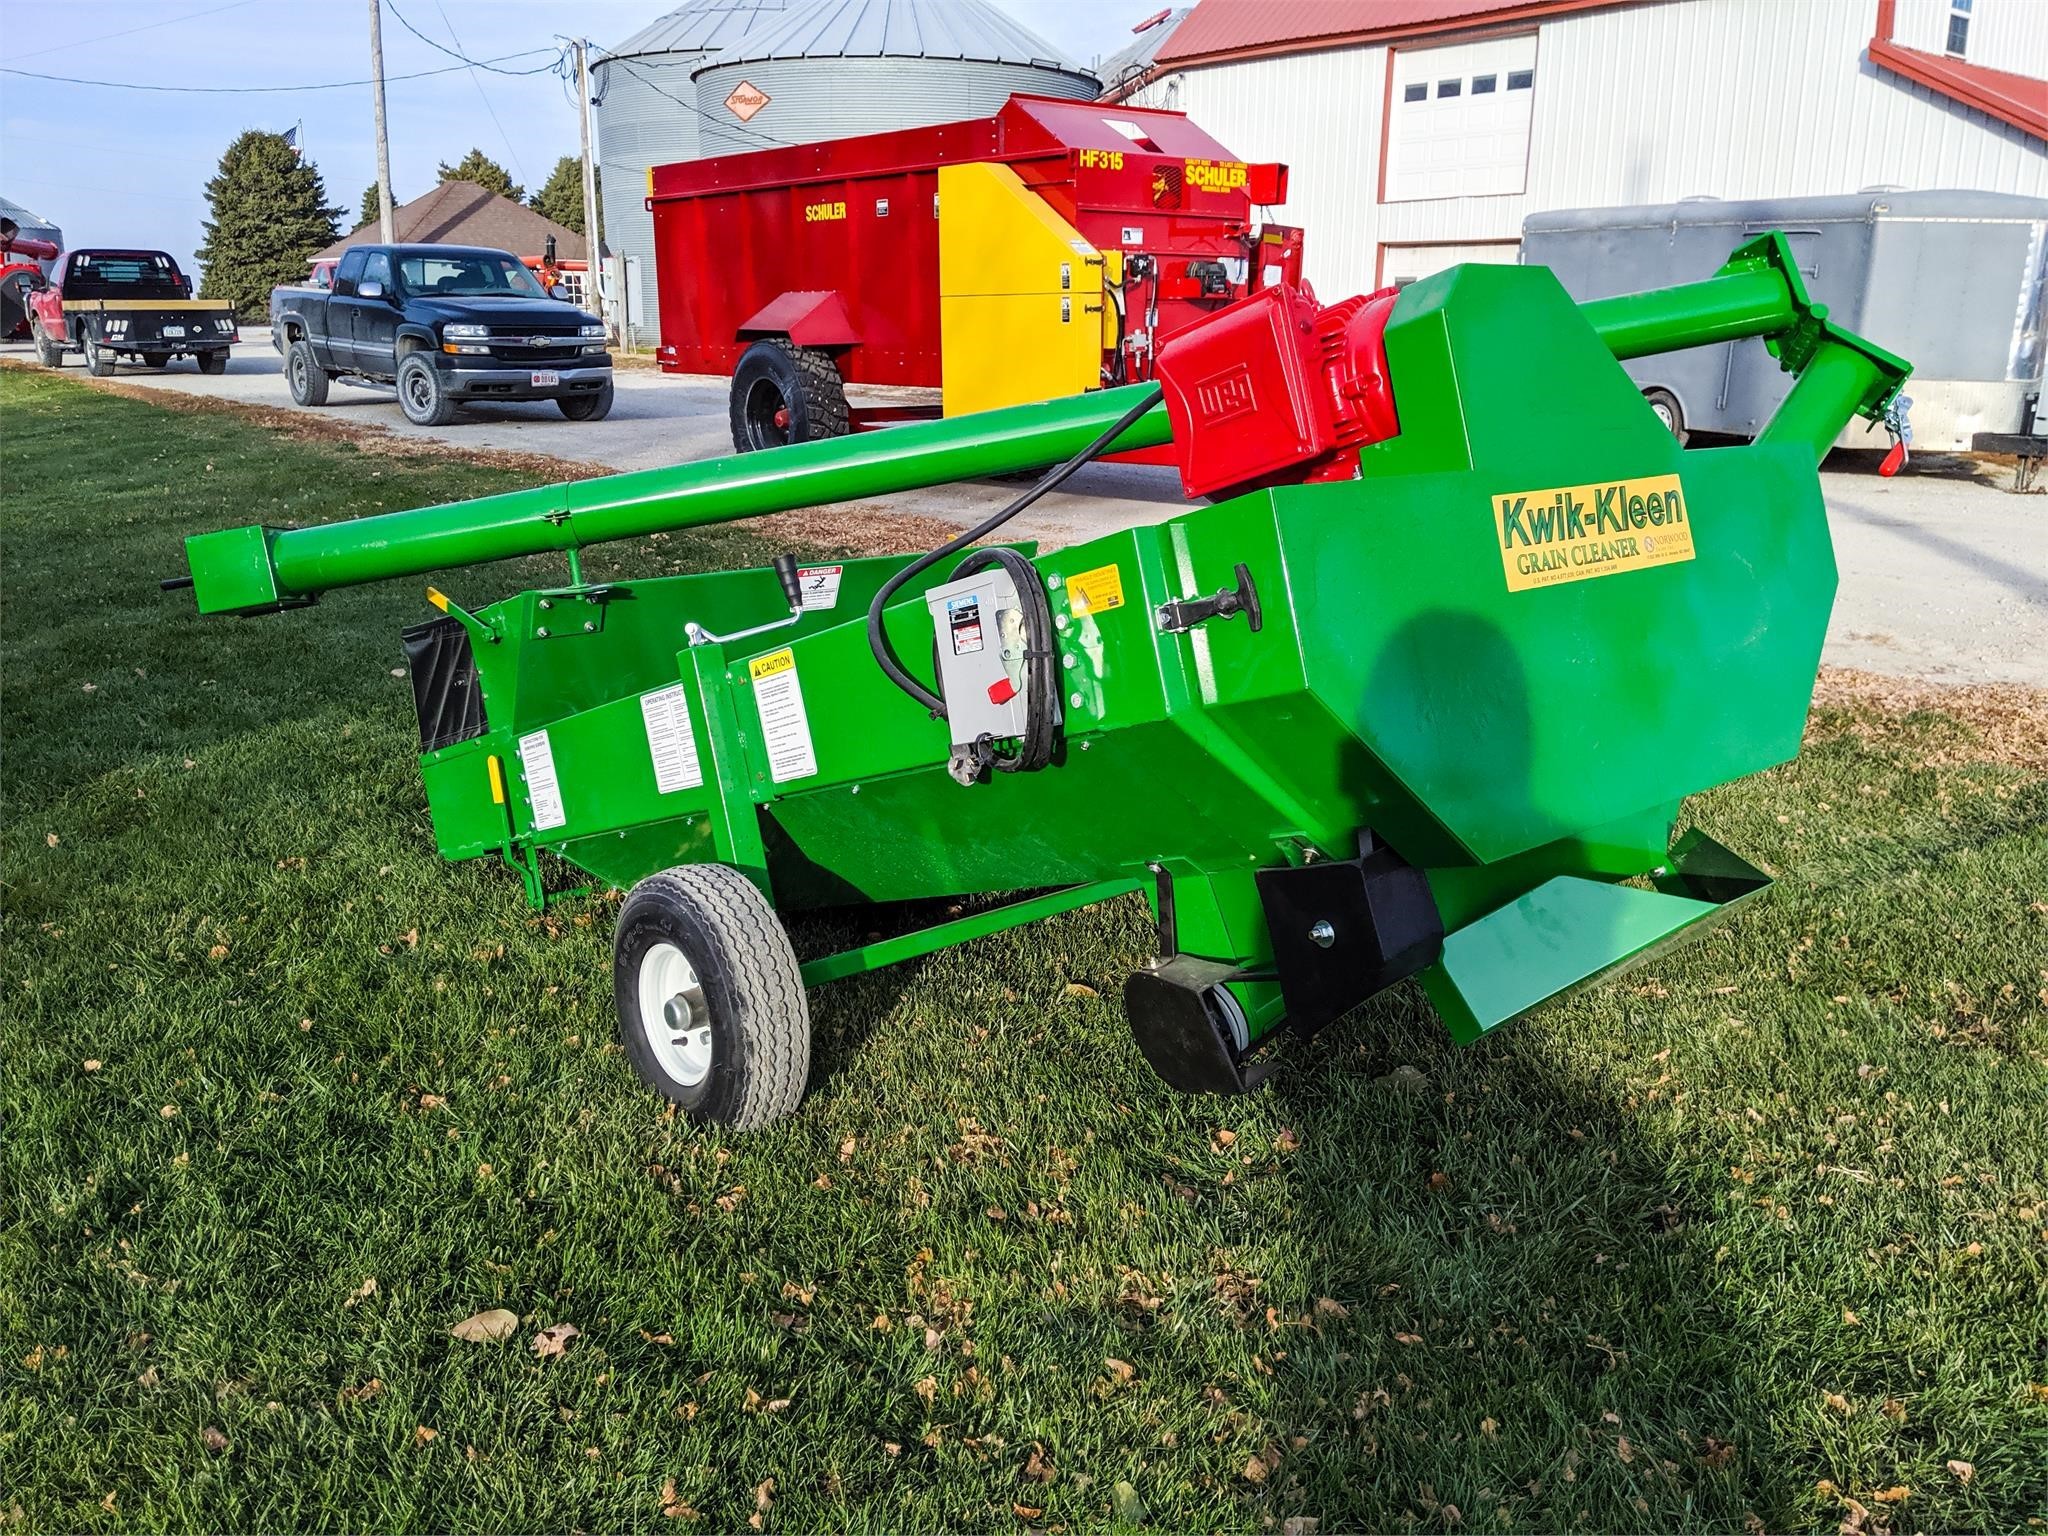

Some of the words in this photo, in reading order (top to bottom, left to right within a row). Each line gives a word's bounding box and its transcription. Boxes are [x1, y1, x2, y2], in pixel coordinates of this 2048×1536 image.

[1079, 149, 1124, 170] HF315
[1185, 165, 1247, 188] SCHULER
[805, 201, 847, 222] SCHULER
[1502, 485, 1683, 550] Kwik-Kleen
[1654, 531, 1688, 545] NORWOOD
[1517, 547, 1569, 576] GRAIN
[1571, 536, 1641, 567] CLEANER
[809, 568, 837, 576] DANGER
[951, 596, 973, 609] SIEMENS
[761, 655, 791, 673] CAUTION
[645, 694, 666, 706] OPERATING
